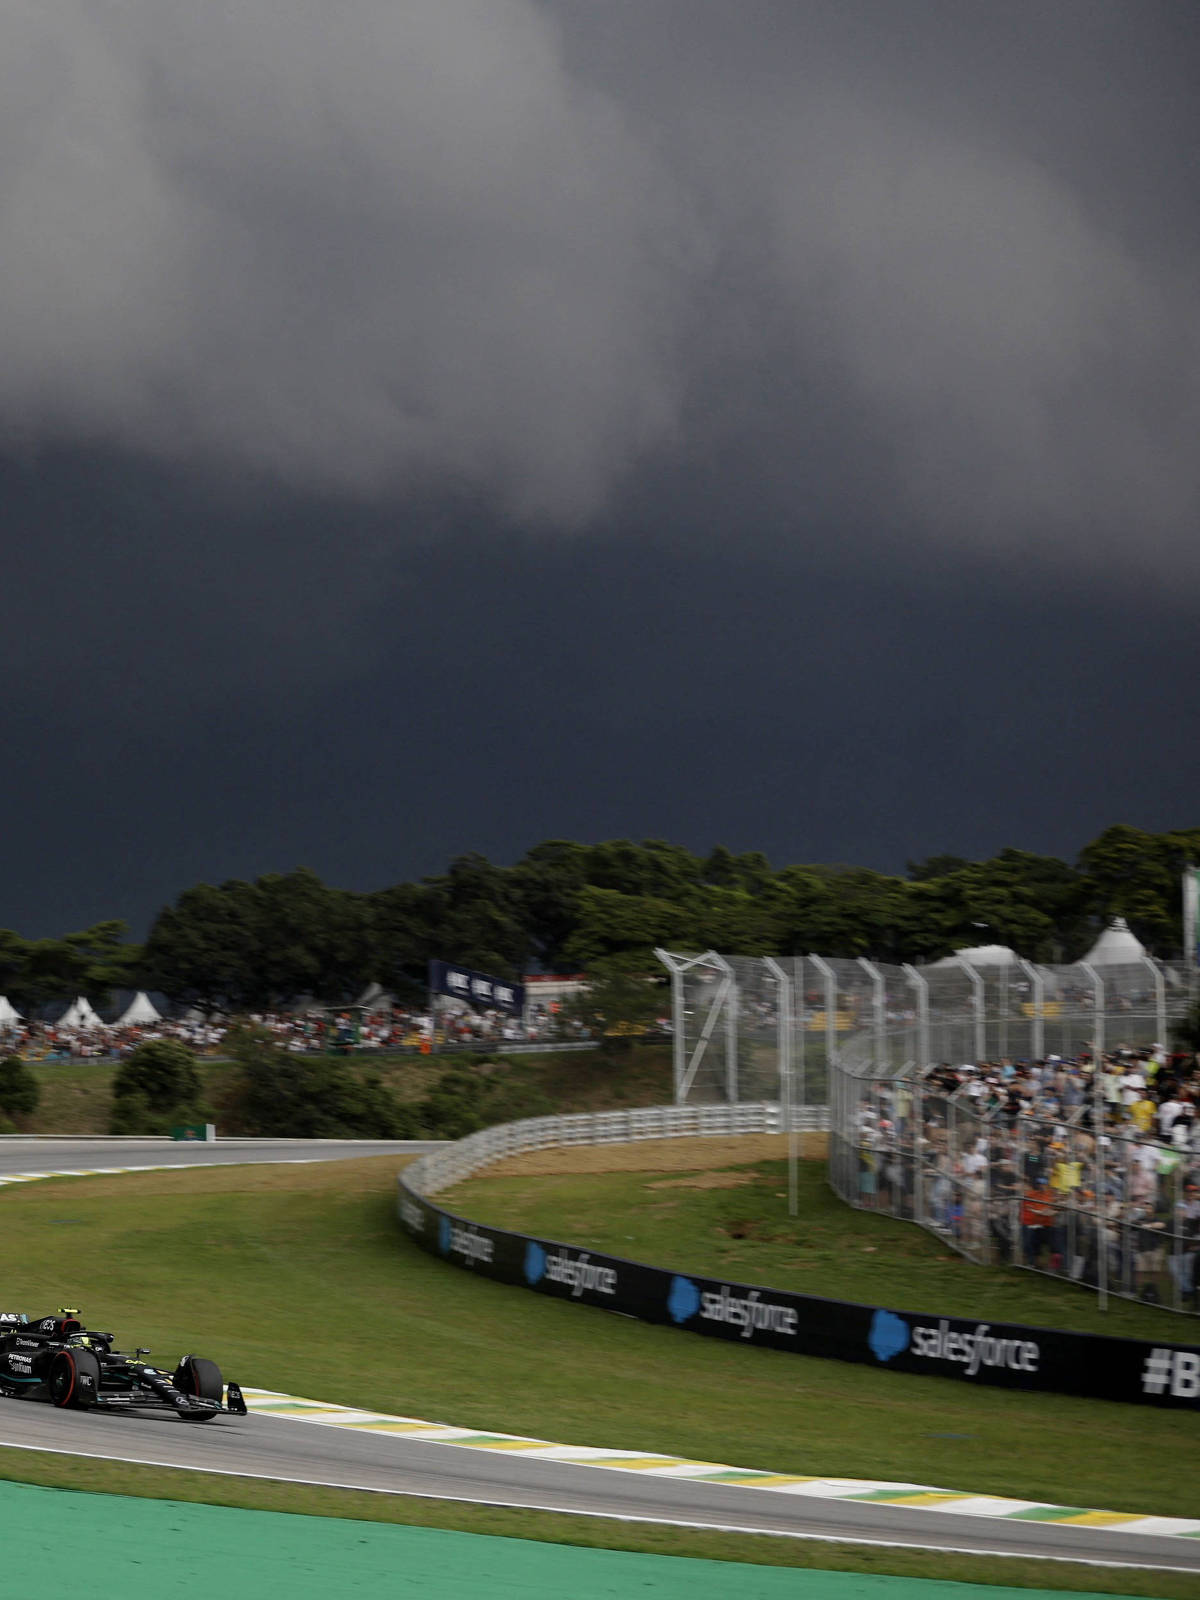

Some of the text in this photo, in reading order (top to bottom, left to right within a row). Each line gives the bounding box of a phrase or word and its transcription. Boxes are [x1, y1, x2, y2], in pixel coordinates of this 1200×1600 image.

[699, 1285, 799, 1338] salesforce
[8, 1353, 32, 1363] PETRONAS
[911, 1319, 1040, 1375] salesforce
